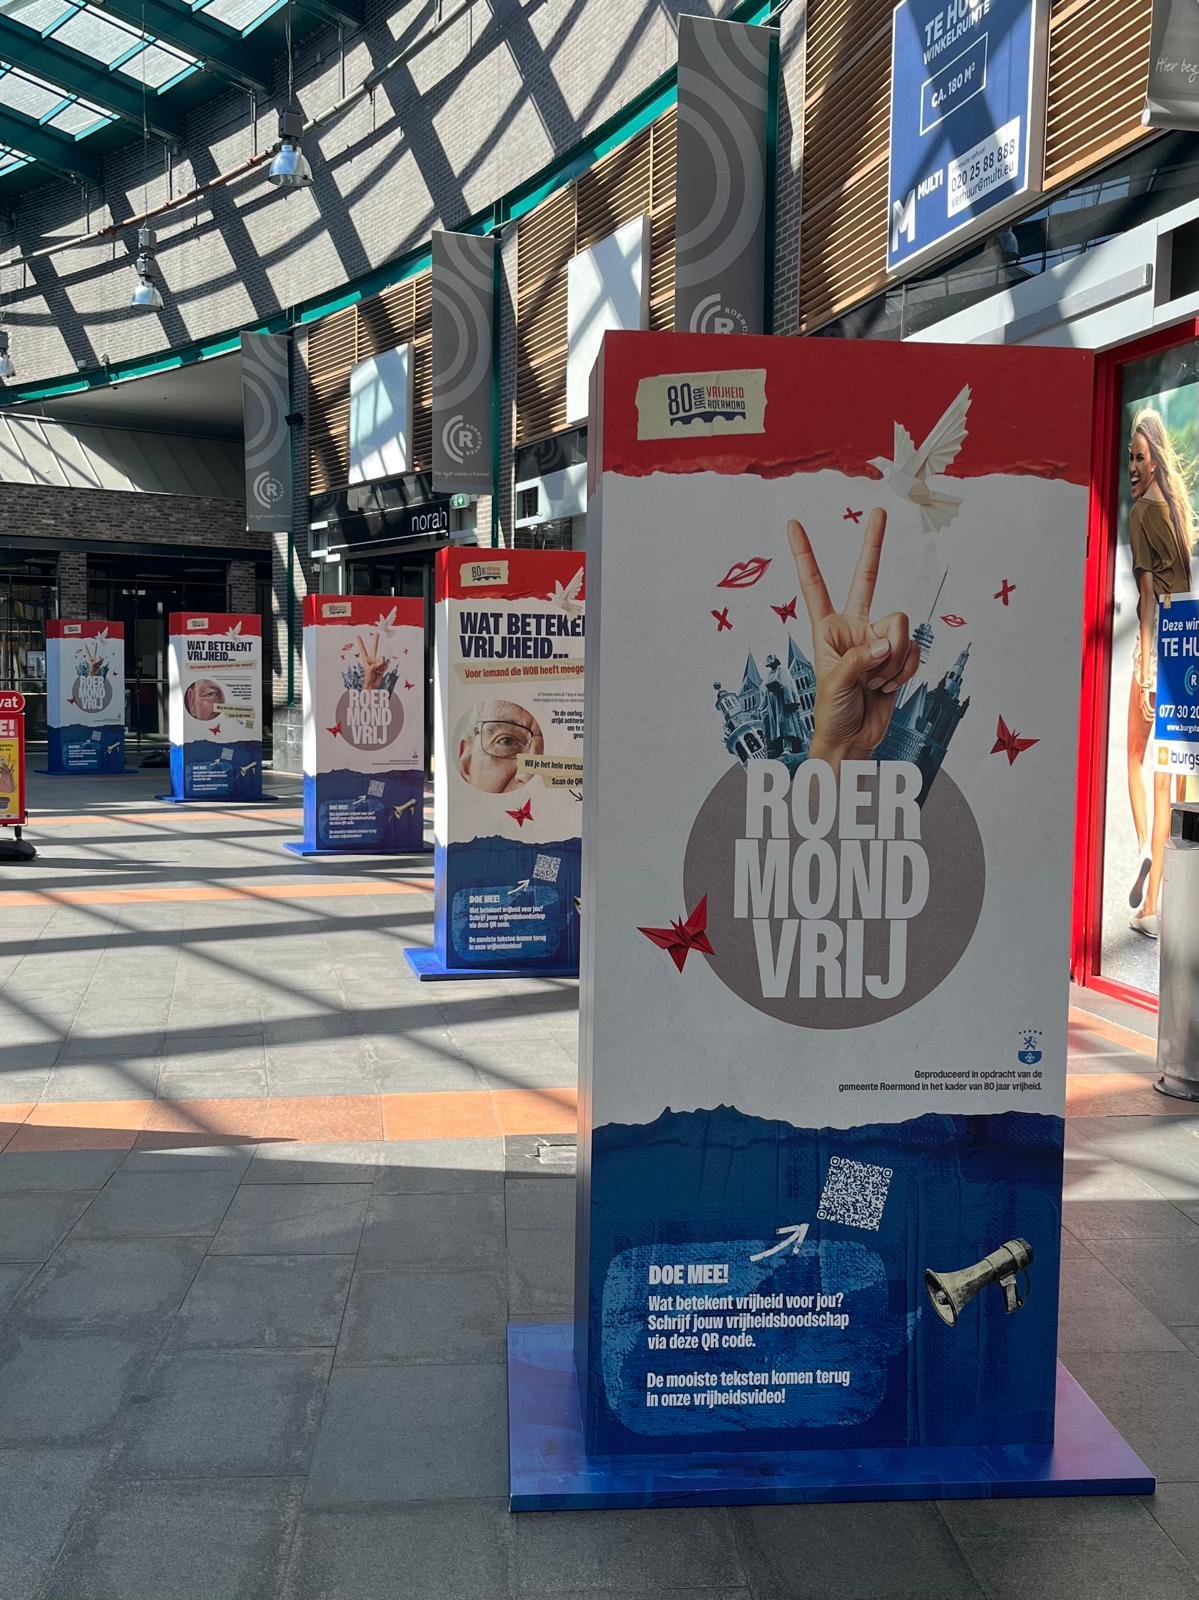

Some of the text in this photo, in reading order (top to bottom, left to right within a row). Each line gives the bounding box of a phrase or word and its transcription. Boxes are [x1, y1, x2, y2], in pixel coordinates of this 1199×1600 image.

[924, 0, 989, 65] WINKELRUIMTE
[925, 12, 944, 46] TE
[1155, 57, 1178, 72] Hier
[931, 89, 946, 107] CA.
[948, 73, 962, 95] 180
[952, 170, 967, 192] 020
[970, 161, 980, 180] 25
[983, 152, 994, 172] 88
[997, 139, 1015, 162] 888
[918, 169, 943, 200] MULTI
[952, 162, 1014, 208] verhuur@multi.eu
[668, 383, 744, 416] 80 JAAR VRIJHEID
[708, 400, 746, 410] ROERMOND
[459, 430, 473, 448] R
[266, 483, 278, 496] R
[412, 508, 447, 531] norah
[460, 612, 503, 635] WAT
[1163, 619, 1183, 631] Deze
[187, 641, 253, 652] WAT BETEKENT
[460, 636, 569, 659] VRIJHEID...
[1162, 638, 1179, 657] TE
[465, 669, 482, 678] Voor
[511, 667, 521, 676] die
[540, 666, 559, 674] heeft
[1191, 675, 1197, 686] R
[80, 676, 104, 688] ROER
[79, 687, 106, 699] MOND
[350, 689, 390, 708] ROER
[82, 698, 103, 710] VRIJ
[1159, 705, 1175, 718] 077
[1177, 705, 1188, 718] 30
[347, 708, 392, 726] MOND
[352, 726, 388, 745] VRIJ
[534, 760, 540, 768] je
[745, 759, 923, 840] ROER
[734, 838, 930, 919] MOND
[752, 919, 907, 999] VRIJ
[915, 1070, 970, 1079] Geproduceerd
[972, 1070, 979, 1078] in
[980, 1070, 1016, 1080] opdracht
[1032, 1070, 1042, 1078] de
[839, 1083, 879, 1092] gemeente
[880, 1083, 920, 1091] Roermond
[995, 1083, 1010, 1092] jaar
[1012, 1082, 1042, 1092] vrijheid.
[649, 1264, 729, 1285] DOE MEE!
[648, 1293, 844, 1312] Wat betekent vrijheid voor jou?
[648, 1312, 849, 1332] Schrijf jouw vrijheidsboodschap
[648, 1333, 756, 1351] via deze QR code.
[647, 1370, 850, 1388] De mooiste teksten komen terug
[647, 1389, 786, 1409] in onze vrijheidsvideo!
